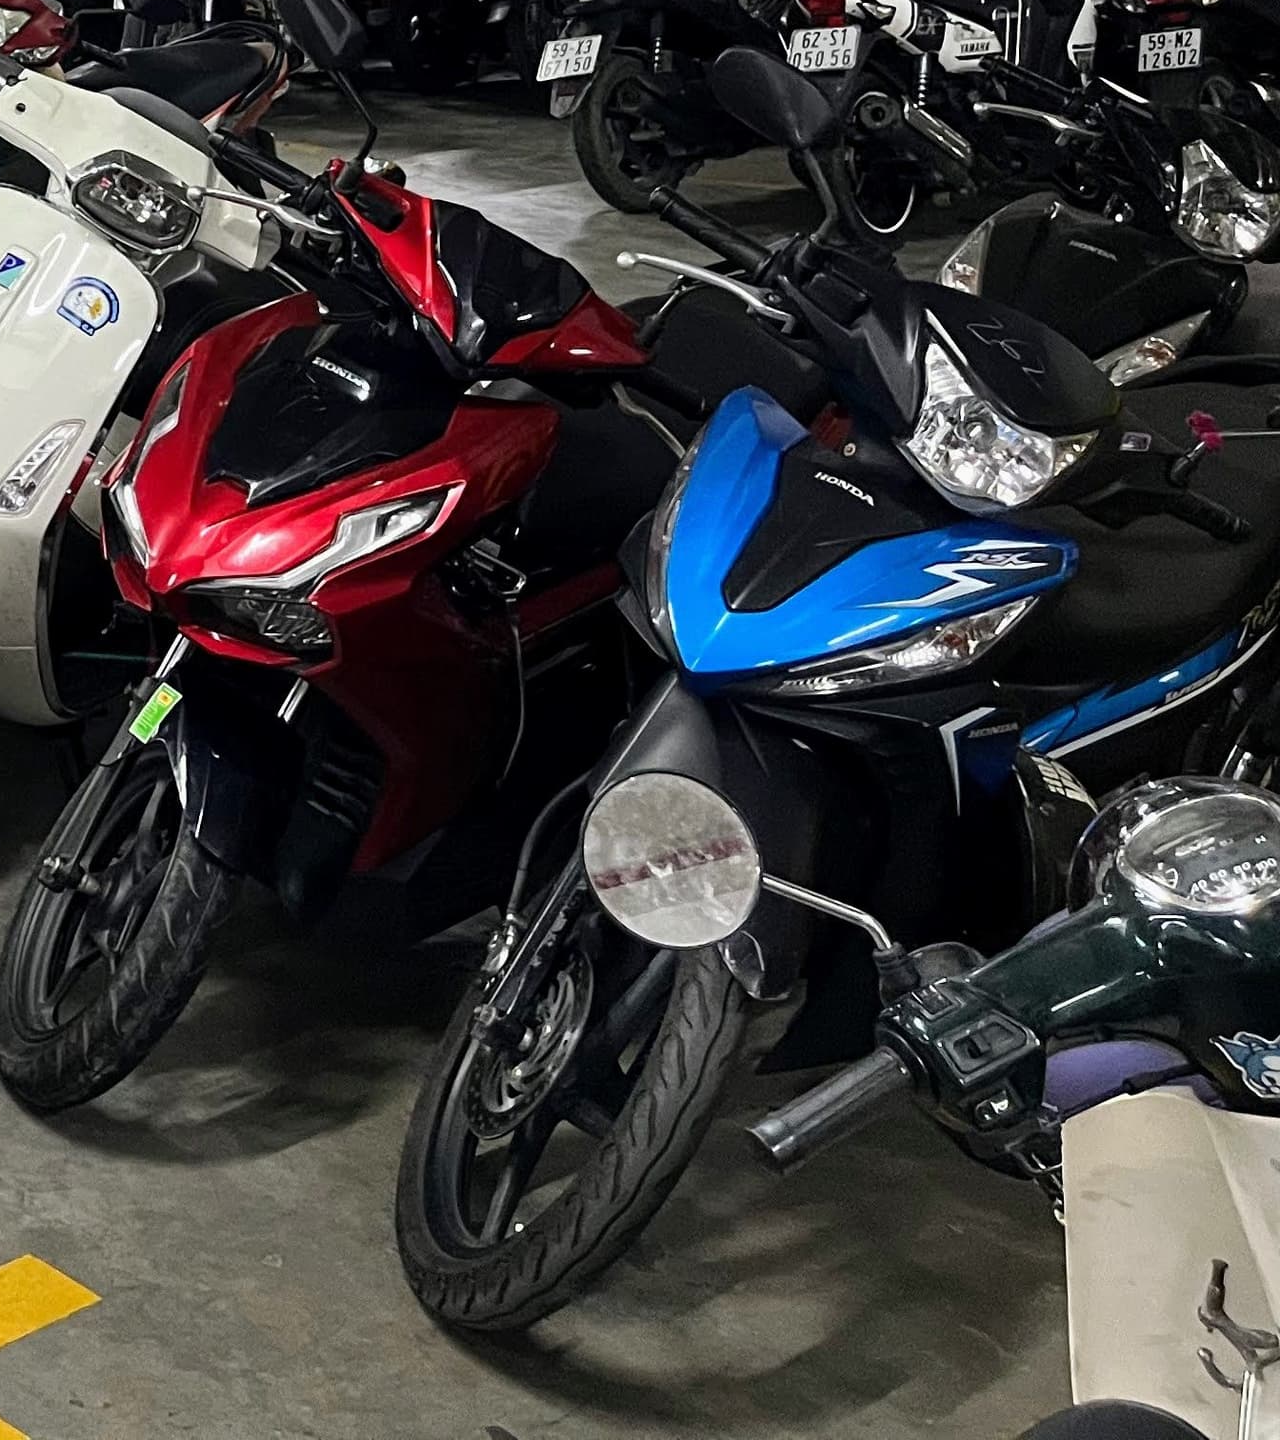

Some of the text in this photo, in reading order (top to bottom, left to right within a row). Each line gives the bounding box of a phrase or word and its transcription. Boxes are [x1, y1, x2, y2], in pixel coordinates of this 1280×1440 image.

[551, 39, 593, 59] 59-X3
[802, 29, 848, 49] 62-S1
[960, 41, 990, 53] YAMAHA
[1148, 30, 1193, 51] 59-M2
[1142, 48, 1197, 70] 126.02
[814, 471, 875, 507] HONDA
[968, 722, 1019, 739] HONDA
